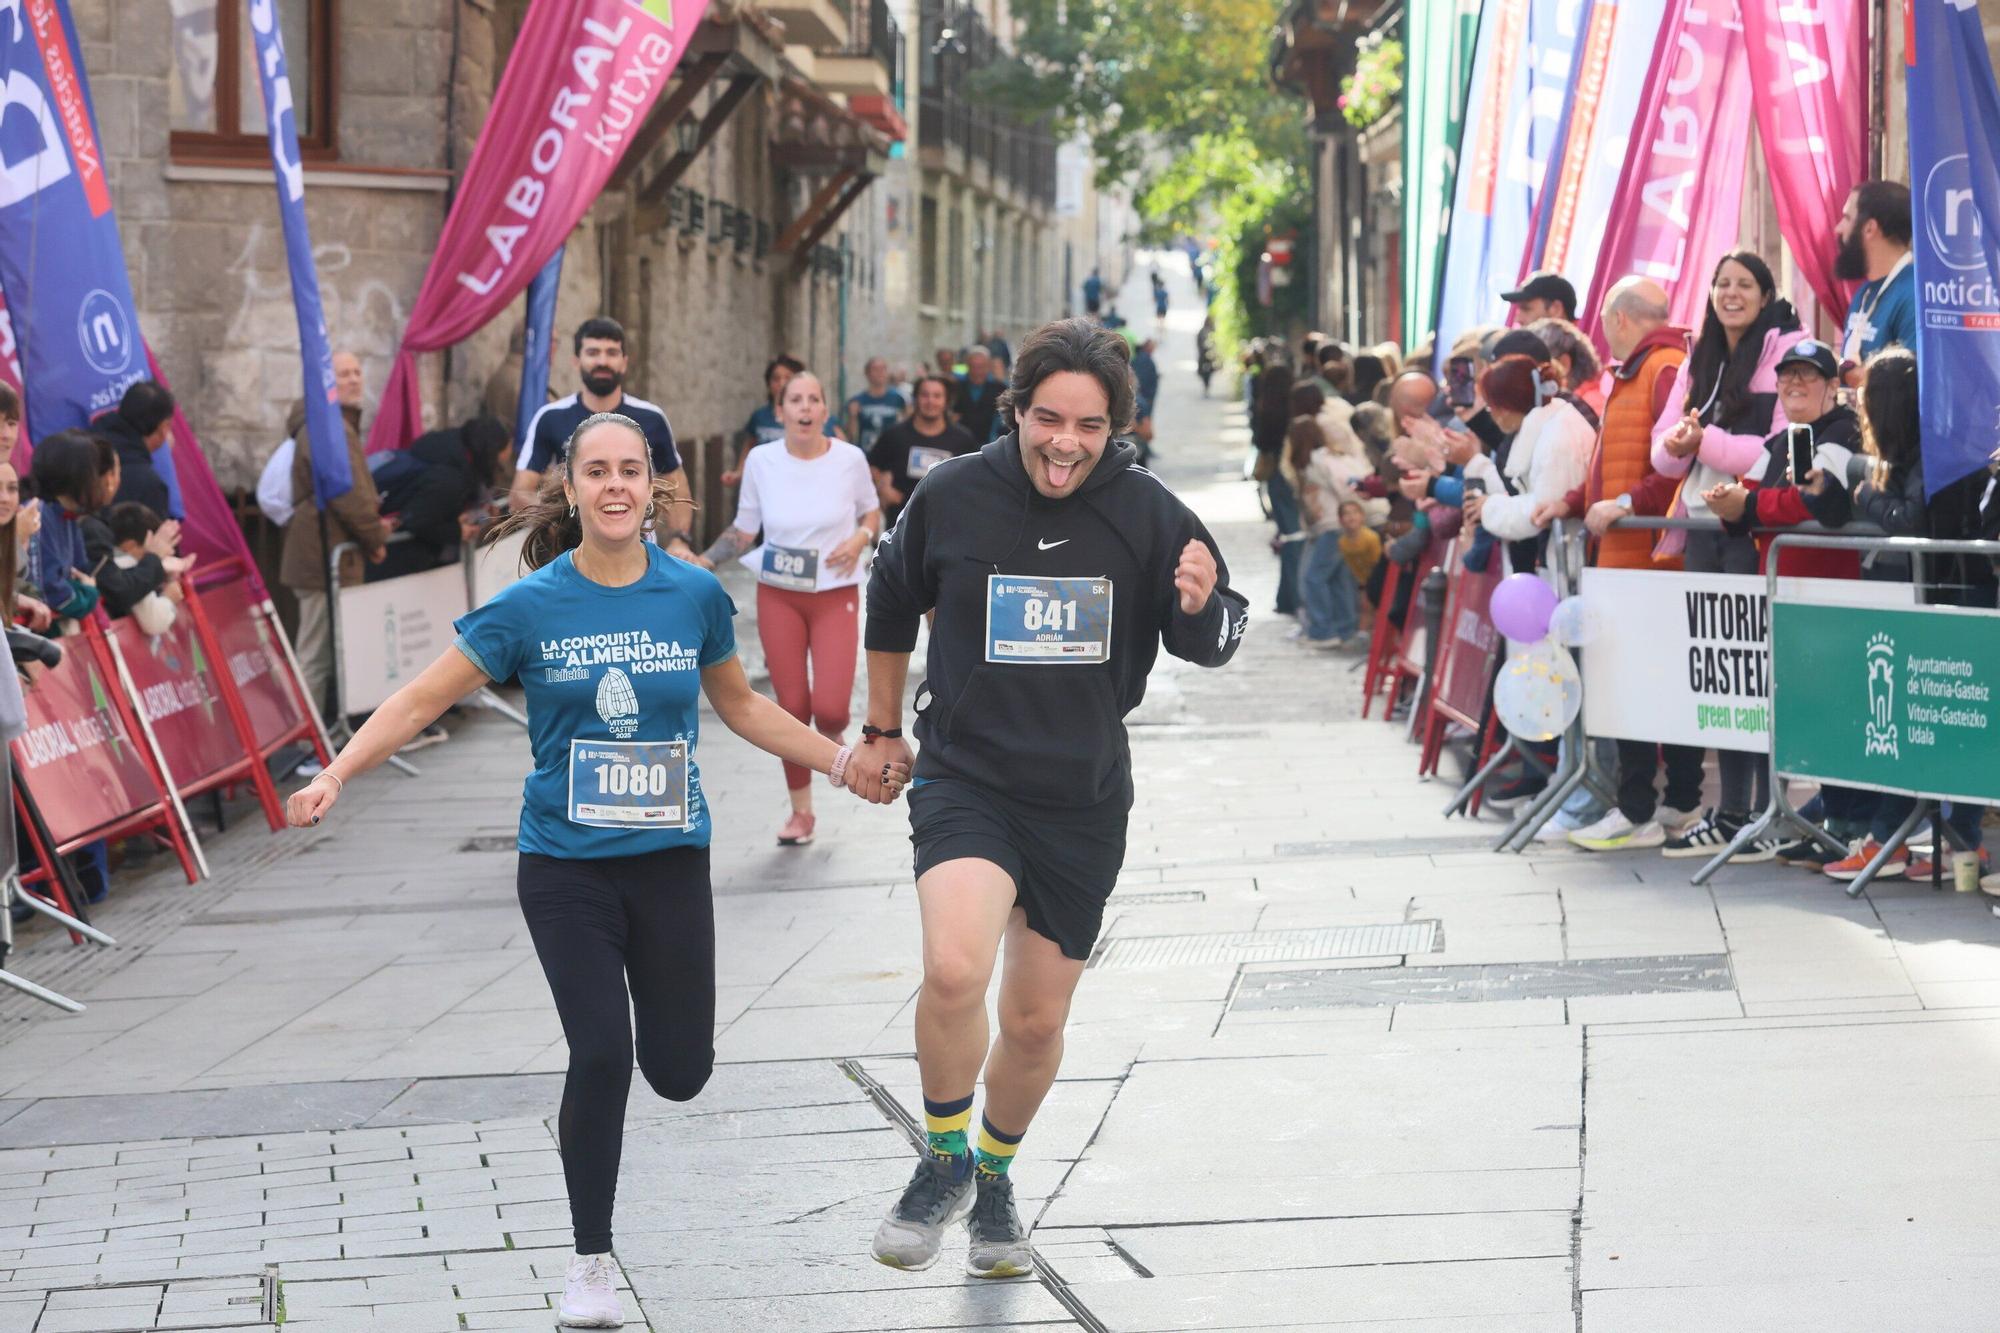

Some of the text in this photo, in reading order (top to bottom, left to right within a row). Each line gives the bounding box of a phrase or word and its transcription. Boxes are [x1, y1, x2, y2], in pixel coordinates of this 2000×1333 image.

[583, 32, 673, 156] kutxa
[457, 15, 632, 295] LABORAL
[1023, 598, 1077, 631] 841
[540, 630, 652, 653] LA CONQUISTA
[1035, 632, 1063, 643] ADRIÁN
[542, 653, 554, 661] DE
[555, 651, 567, 660] LA
[565, 641, 684, 668] ALMENDRA
[631, 658, 697, 675] KONKISTA
[1907, 654, 1973, 677] Ayuntamiento
[553, 667, 590, 683] Edición
[1907, 677, 1990, 702] de Vitoria-Gasteiz
[609, 718, 638, 727] VITORIA
[1697, 703, 1731, 731] green
[1907, 703, 1988, 729] Vitoria-Gasteizko
[609, 726, 638, 734] GASTEIZ
[1908, 726, 1935, 746] Udala
[595, 763, 667, 796] 1080
